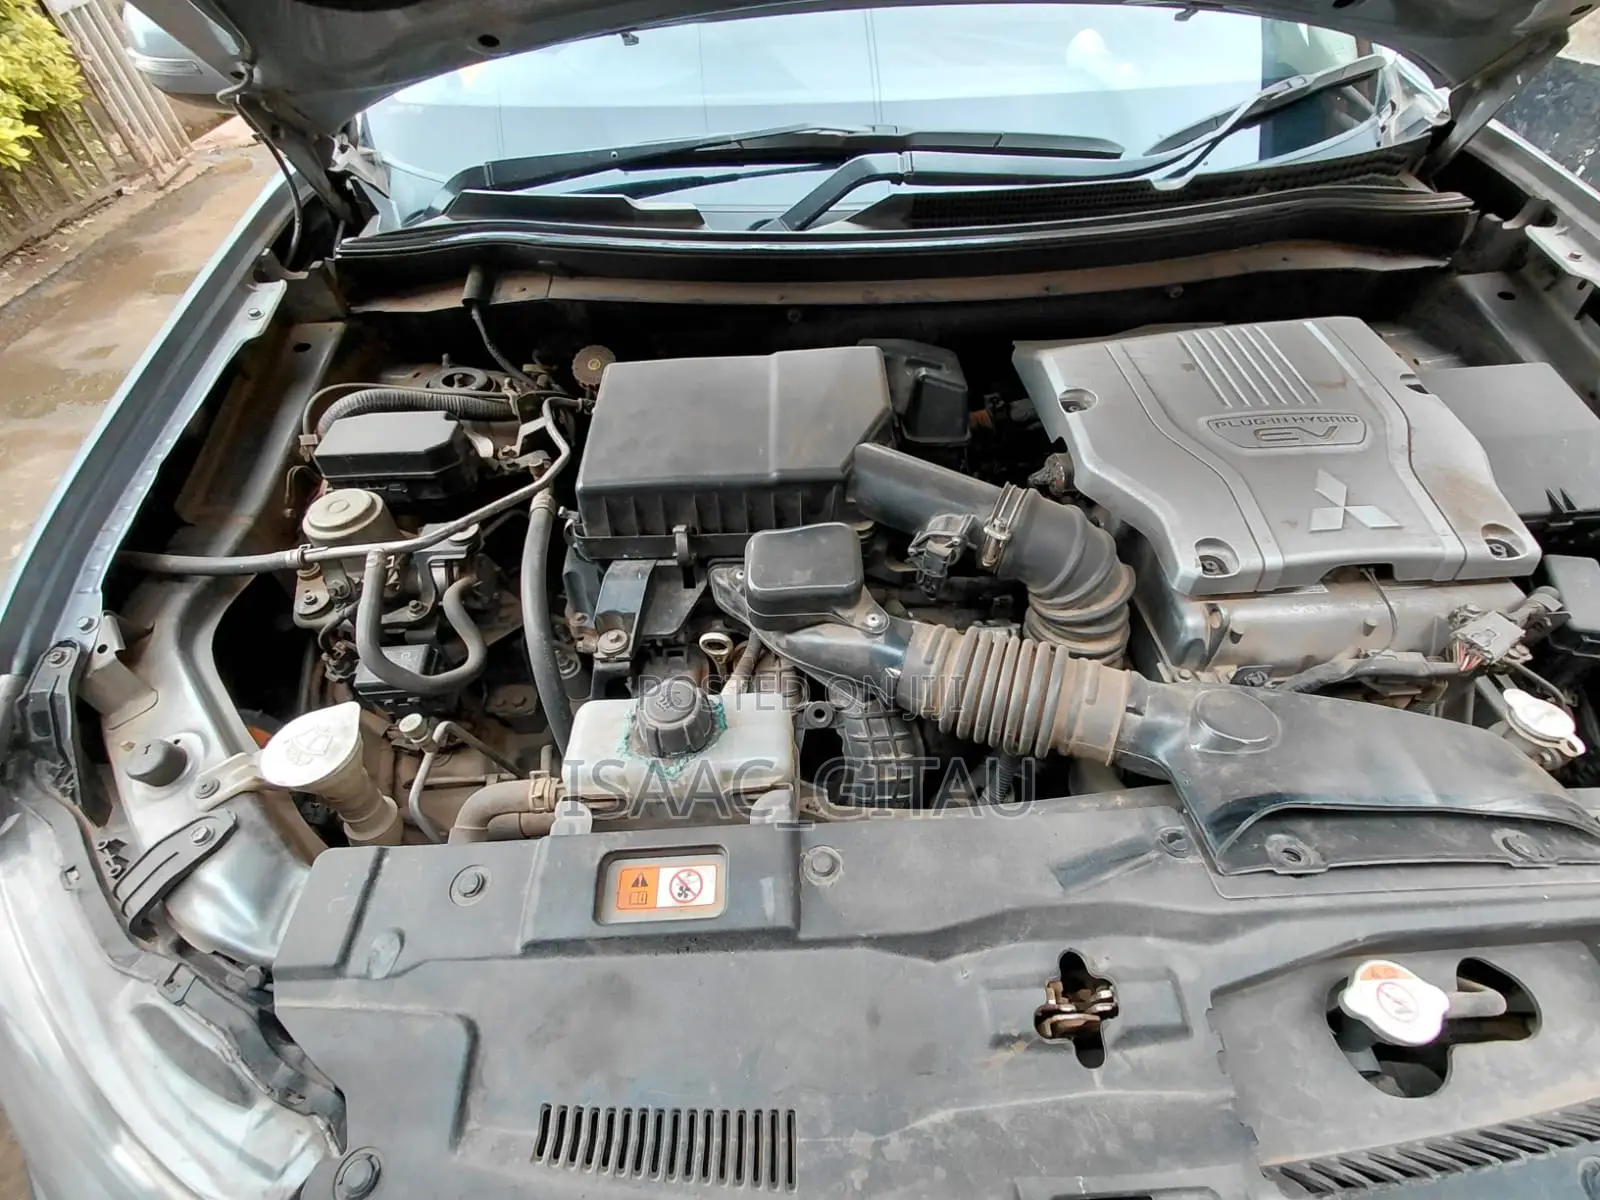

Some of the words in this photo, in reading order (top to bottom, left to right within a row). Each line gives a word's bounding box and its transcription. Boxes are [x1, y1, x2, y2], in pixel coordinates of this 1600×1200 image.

[1214, 417, 1289, 429] PLUG-IN
[1291, 415, 1359, 425] HYBRID
[1253, 426, 1338, 442] EV
